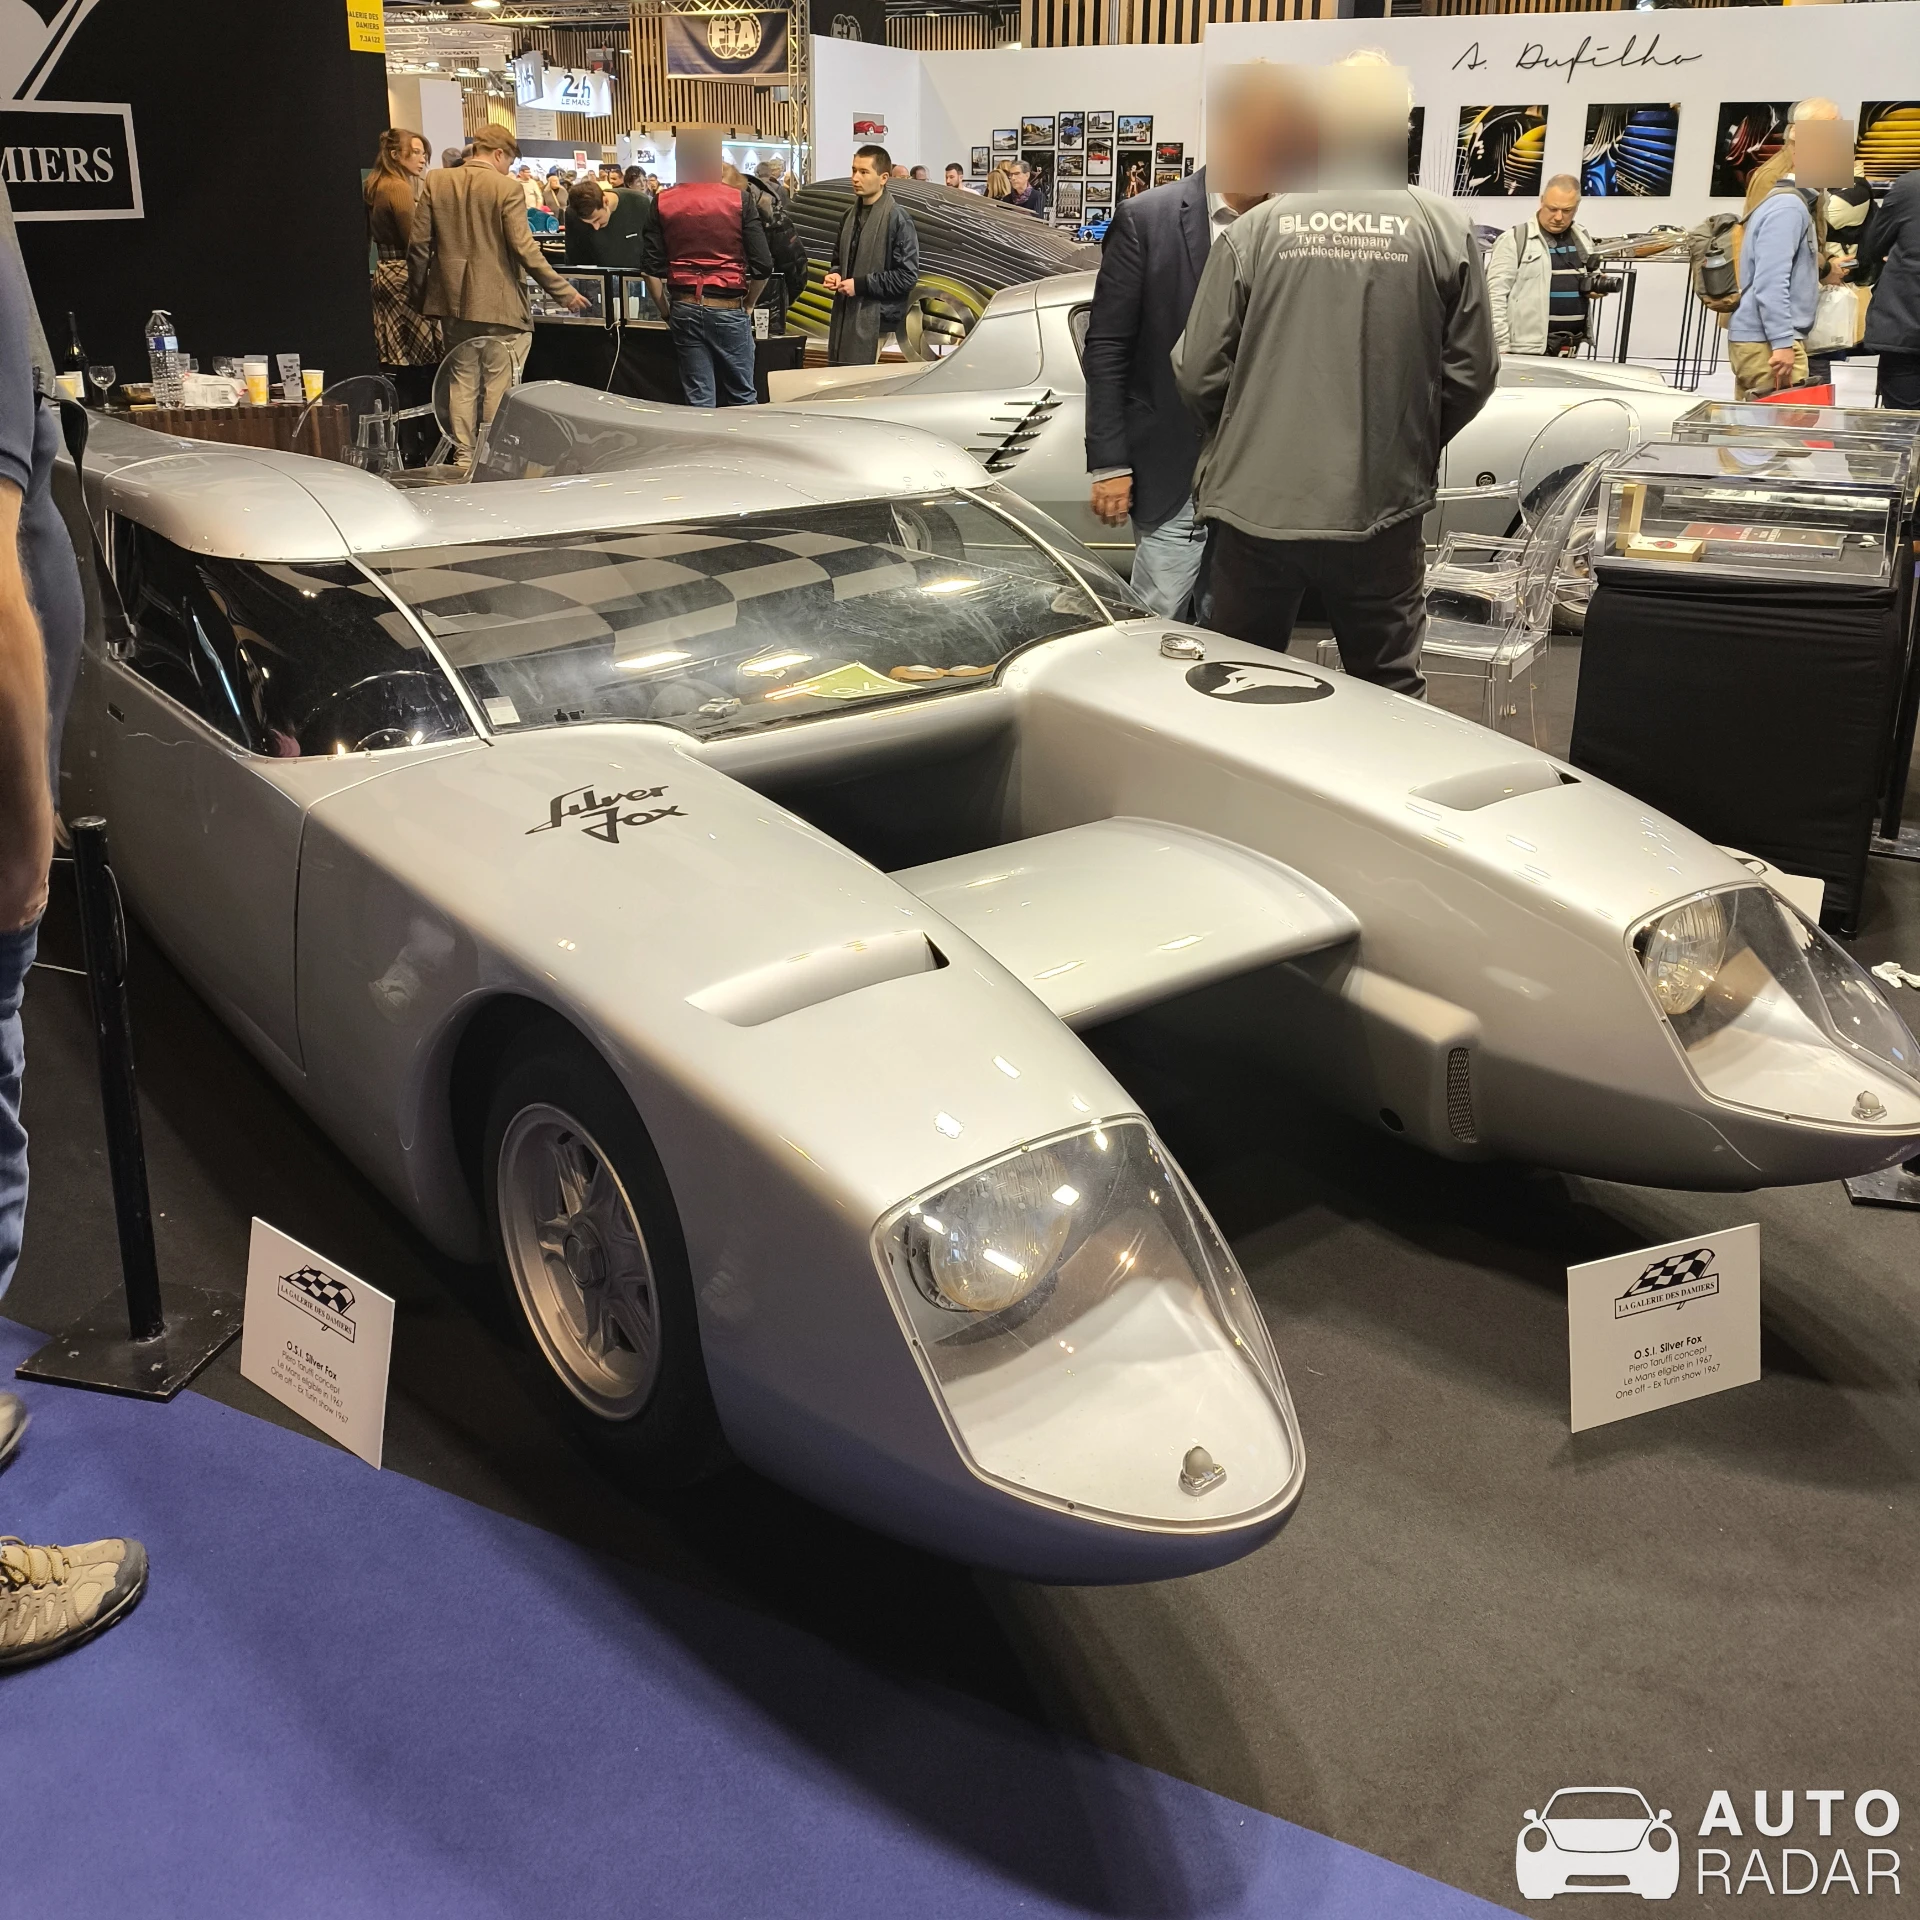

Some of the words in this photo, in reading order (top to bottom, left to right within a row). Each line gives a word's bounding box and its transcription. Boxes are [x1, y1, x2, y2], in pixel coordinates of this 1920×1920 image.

[355, 21, 380, 30] DAMIERS
[1516, 34, 1702, 83] Dufilho
[562, 74, 591, 98] 24h
[1279, 211, 1411, 235] BLOCKLEY
[1278, 246, 1409, 262] www.blockleytyre.com
[1296, 233, 1326, 246] Tyre
[1332, 233, 1392, 250] Company
[525, 784, 669, 835] Silver
[580, 806, 689, 844] Fox
[280, 1285, 288, 1295] LA
[289, 1289, 313, 1310] GALERIE
[314, 1304, 325, 1318] DES
[325, 1313, 352, 1334] DAMIERS
[1618, 1305, 1629, 1313] LA
[1630, 1295, 1664, 1309] GALERIE
[1665, 1291, 1680, 1300] DES
[1681, 1282, 1715, 1297] DAMIERS
[286, 1340, 303, 1359] O.S.I.
[305, 1352, 323, 1371] Silver
[324, 1365, 337, 1381] Fox
[1629, 1362, 1649, 1373] Piero
[1650, 1354, 1673, 1367] Taruffi
[1674, 1345, 1707, 1361] concept
[1634, 1346, 1657, 1359] O.S.I.
[1660, 1340, 1684, 1353] Silver
[1686, 1335, 1702, 1346] Fox
[277, 1359, 284, 1370] Le
[285, 1364, 300, 1381] Mans
[301, 1376, 323, 1394] eligible
[330, 1394, 343, 1408] 1967
[282, 1350, 296, 1366] Piero
[297, 1359, 314, 1377] Taruffi
[314, 1373, 340, 1395] concept
[1615, 1389, 1633, 1399] One
[1634, 1384, 1646, 1394] off
[1653, 1380, 1662, 1389] Ex
[1663, 1376, 1680, 1386] Turin
[1681, 1371, 1701, 1381] show
[1704, 1363, 1721, 1375] 1967
[1623, 1378, 1633, 1386] Le
[1634, 1371, 1656, 1383] Mans
[1657, 1363, 1685, 1376] eligible
[1686, 1360, 1694, 1369] in
[1695, 1355, 1713, 1365] 1967
[270, 1366, 283, 1381] One
[297, 1384, 304, 1395] Ex
[305, 1389, 318, 1403] Turin
[318, 1399, 334, 1415] show
[335, 1410, 349, 1424] 1967
